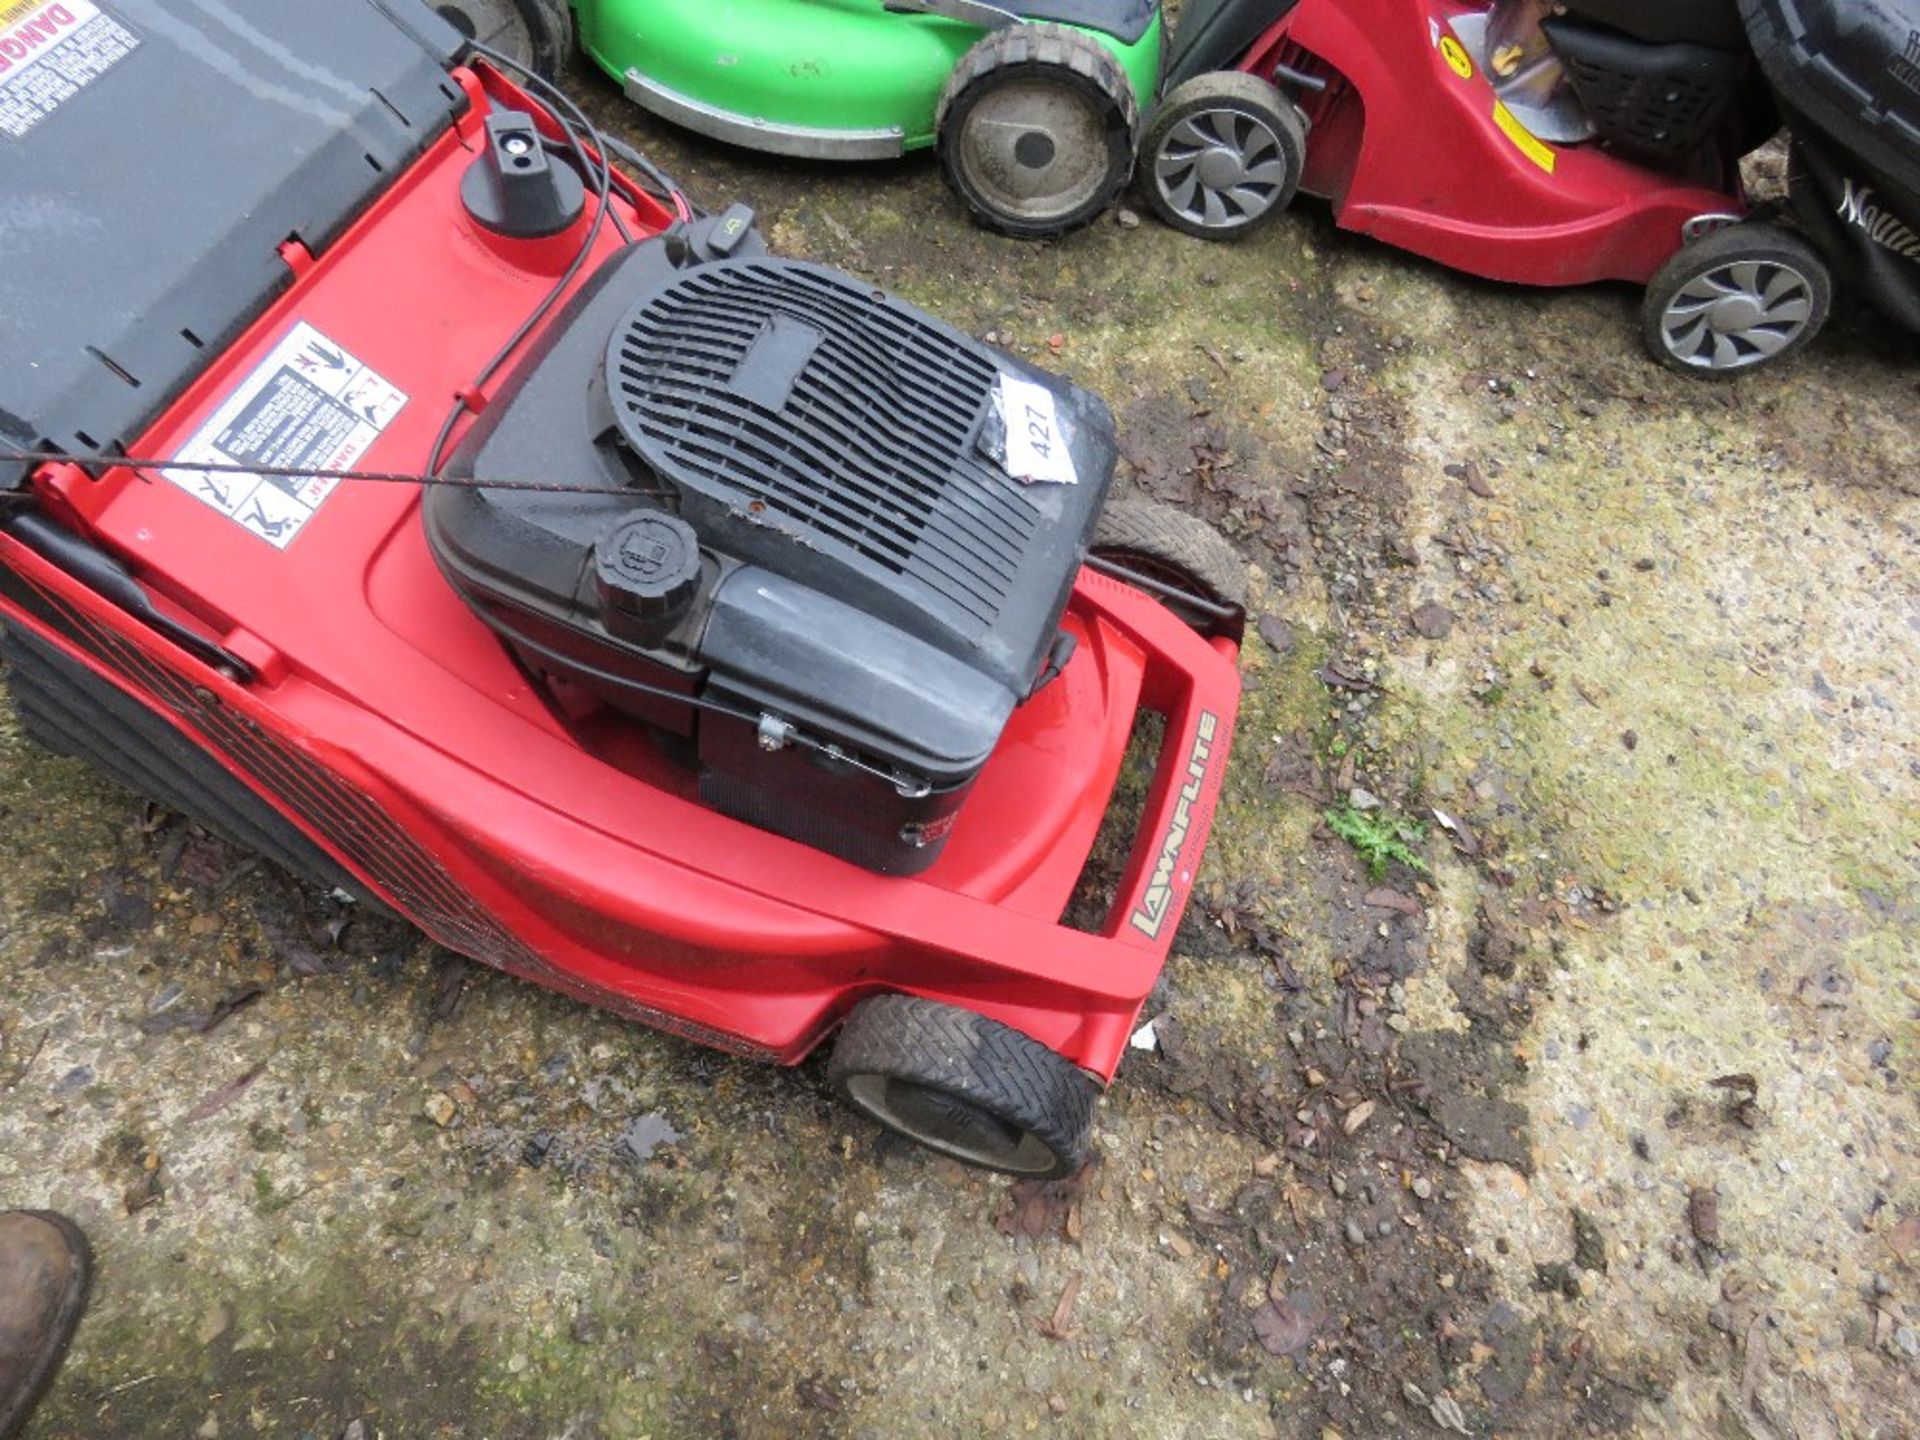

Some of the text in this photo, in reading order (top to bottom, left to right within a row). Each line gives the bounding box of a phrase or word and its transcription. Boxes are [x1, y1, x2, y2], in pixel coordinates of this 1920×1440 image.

[1025, 404, 1051, 459] 427
[309, 443, 356, 496] DANER
[1131, 709, 1217, 941] LAWNFLITE
